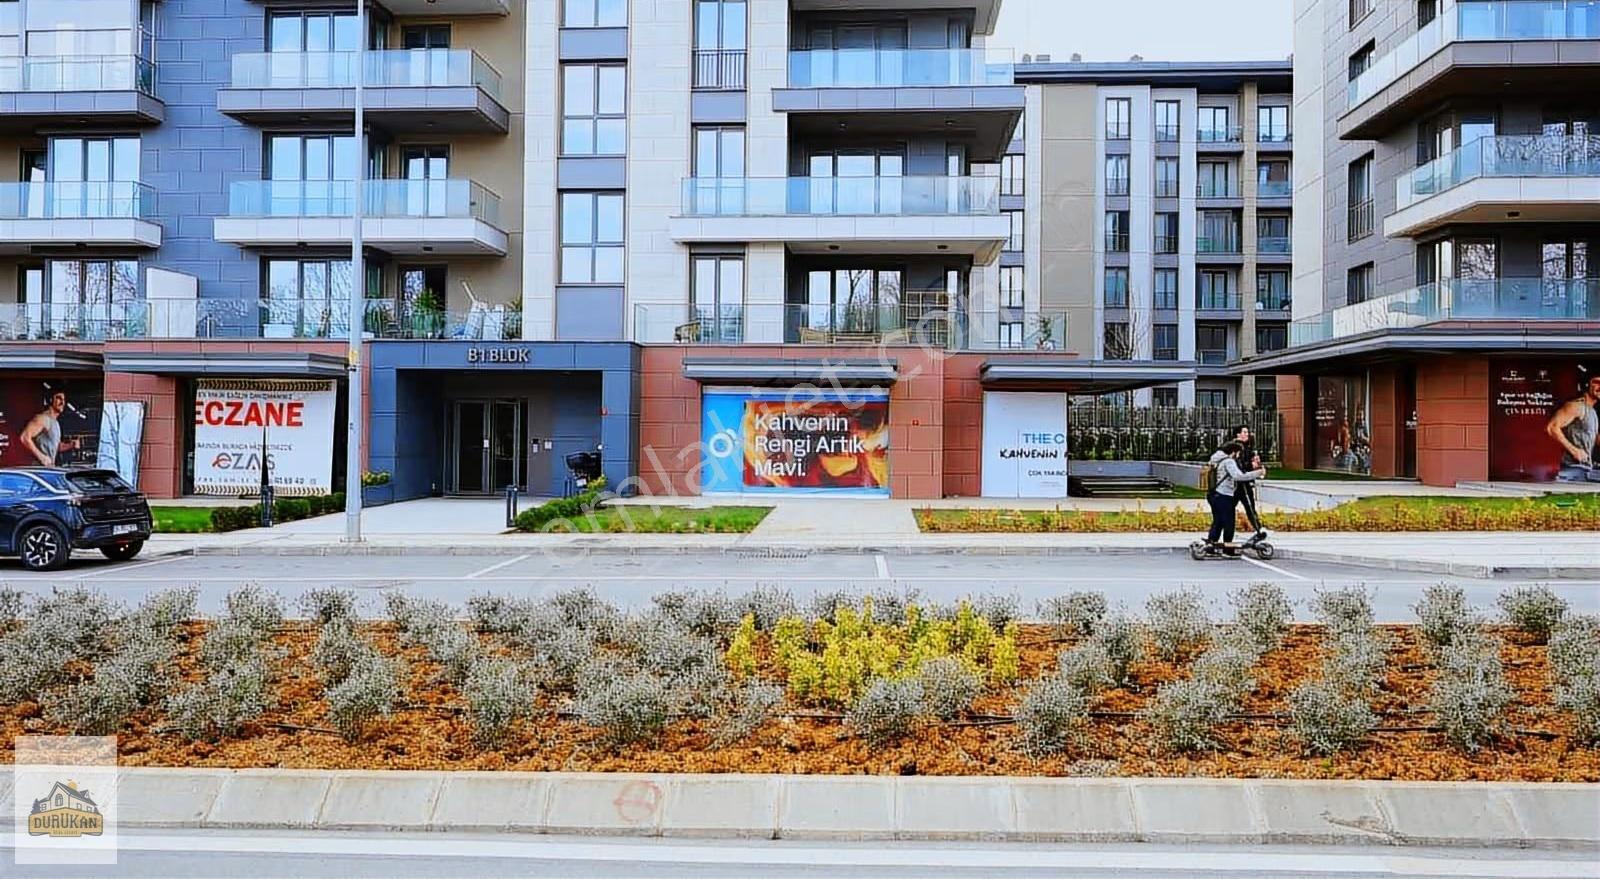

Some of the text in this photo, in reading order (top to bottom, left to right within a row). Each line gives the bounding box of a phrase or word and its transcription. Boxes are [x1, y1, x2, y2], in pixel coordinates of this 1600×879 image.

[468, 347, 529, 362] B1 BLOK
[755, 412, 849, 432] Kahvenin
[755, 435, 865, 457] Rengi Artık
[1022, 433, 1052, 444] THE
[754, 459, 806, 477] Mavi.
